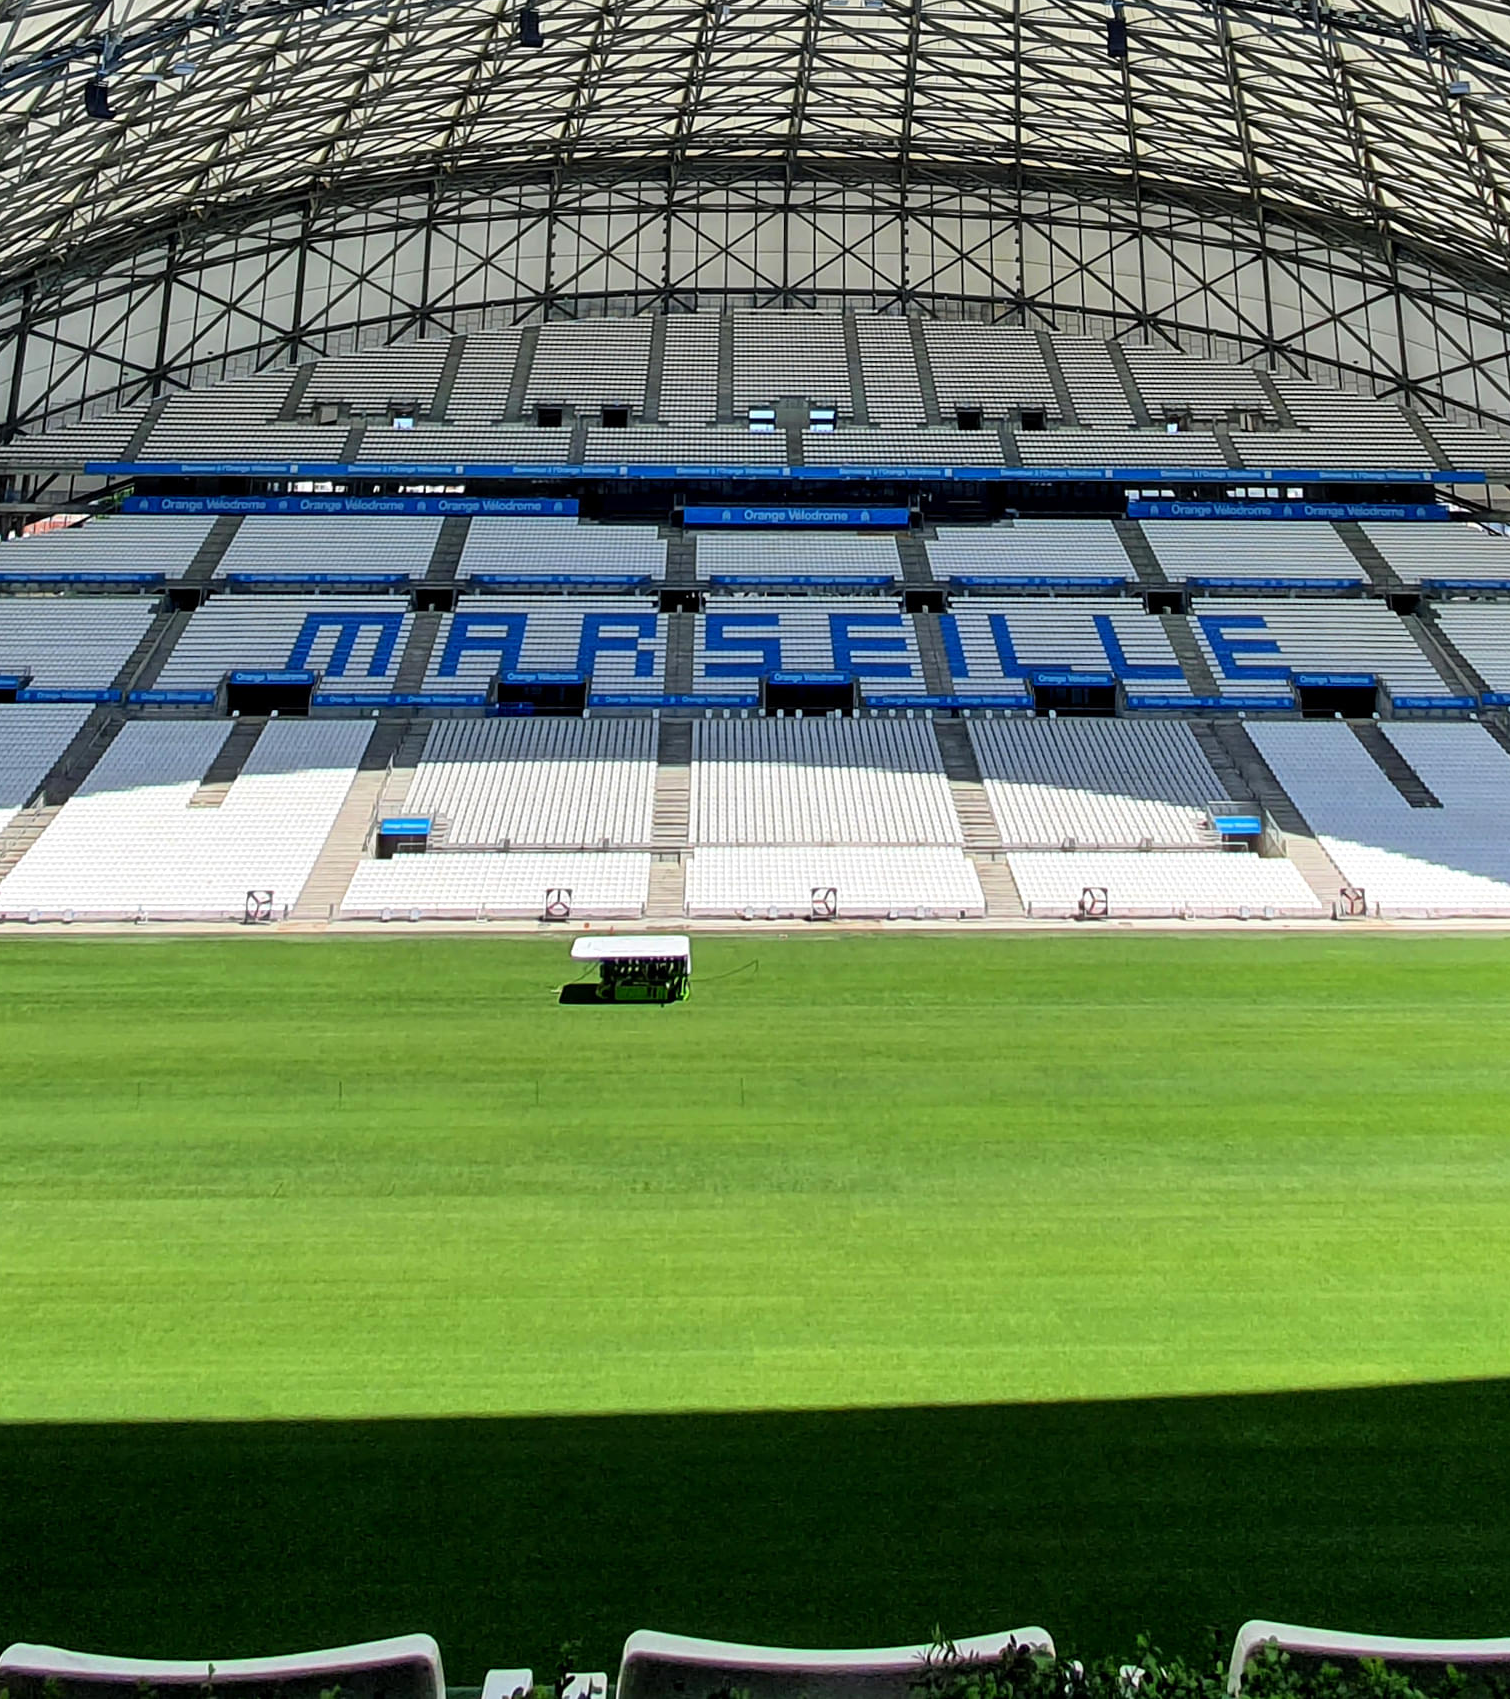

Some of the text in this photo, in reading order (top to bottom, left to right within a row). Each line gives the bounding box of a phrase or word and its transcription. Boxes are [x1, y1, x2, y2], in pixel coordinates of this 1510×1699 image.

[162, 500, 202, 513] Orange
[300, 500, 341, 512] Orange
[438, 501, 479, 513] Orange
[1171, 504, 1211, 516] Orange
[1304, 506, 1344, 517] Orange
[744, 510, 785, 522] Orange
[286, 613, 1291, 679] MARSEILLE
